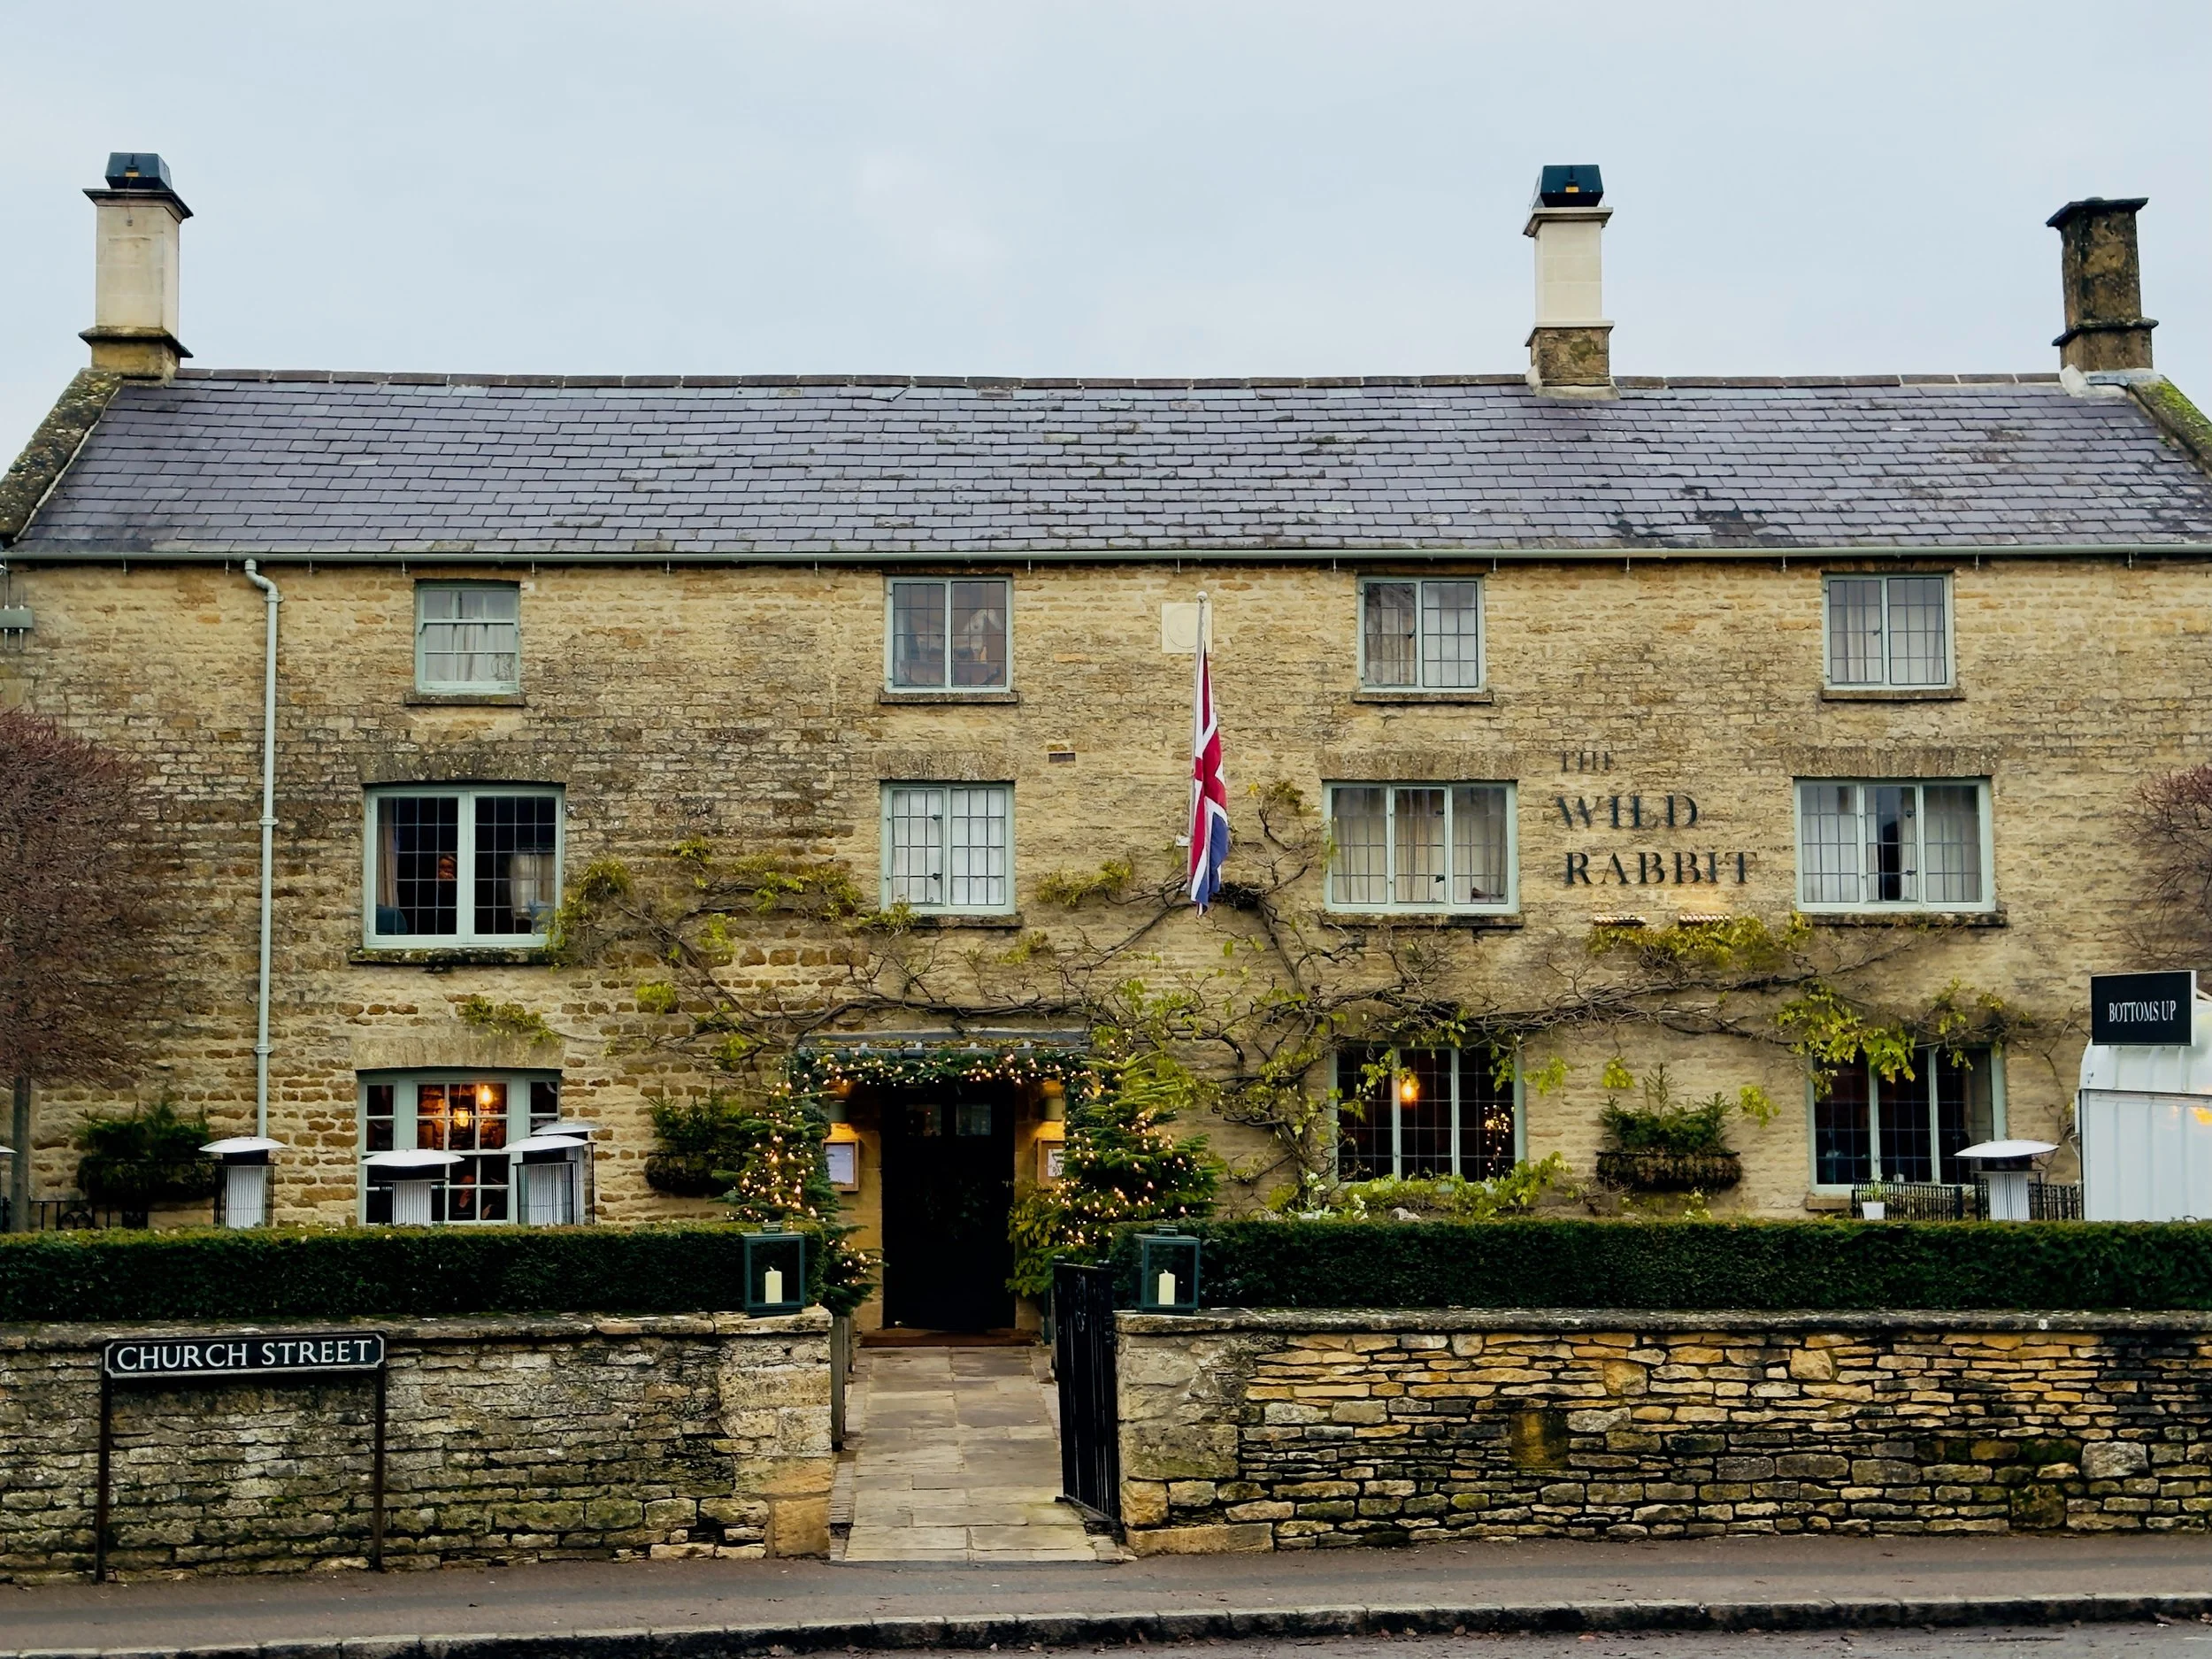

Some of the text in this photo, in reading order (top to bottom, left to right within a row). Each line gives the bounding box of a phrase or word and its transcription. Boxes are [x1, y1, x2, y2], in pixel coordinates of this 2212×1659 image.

[1559, 749, 1616, 772] THE
[1554, 795, 1698, 830] WILD
[1564, 850, 1758, 886] RABBIT
[2108, 1000, 2177, 1023] BOTTOMS UP
[117, 1339, 373, 1371] CHURCH STREET
